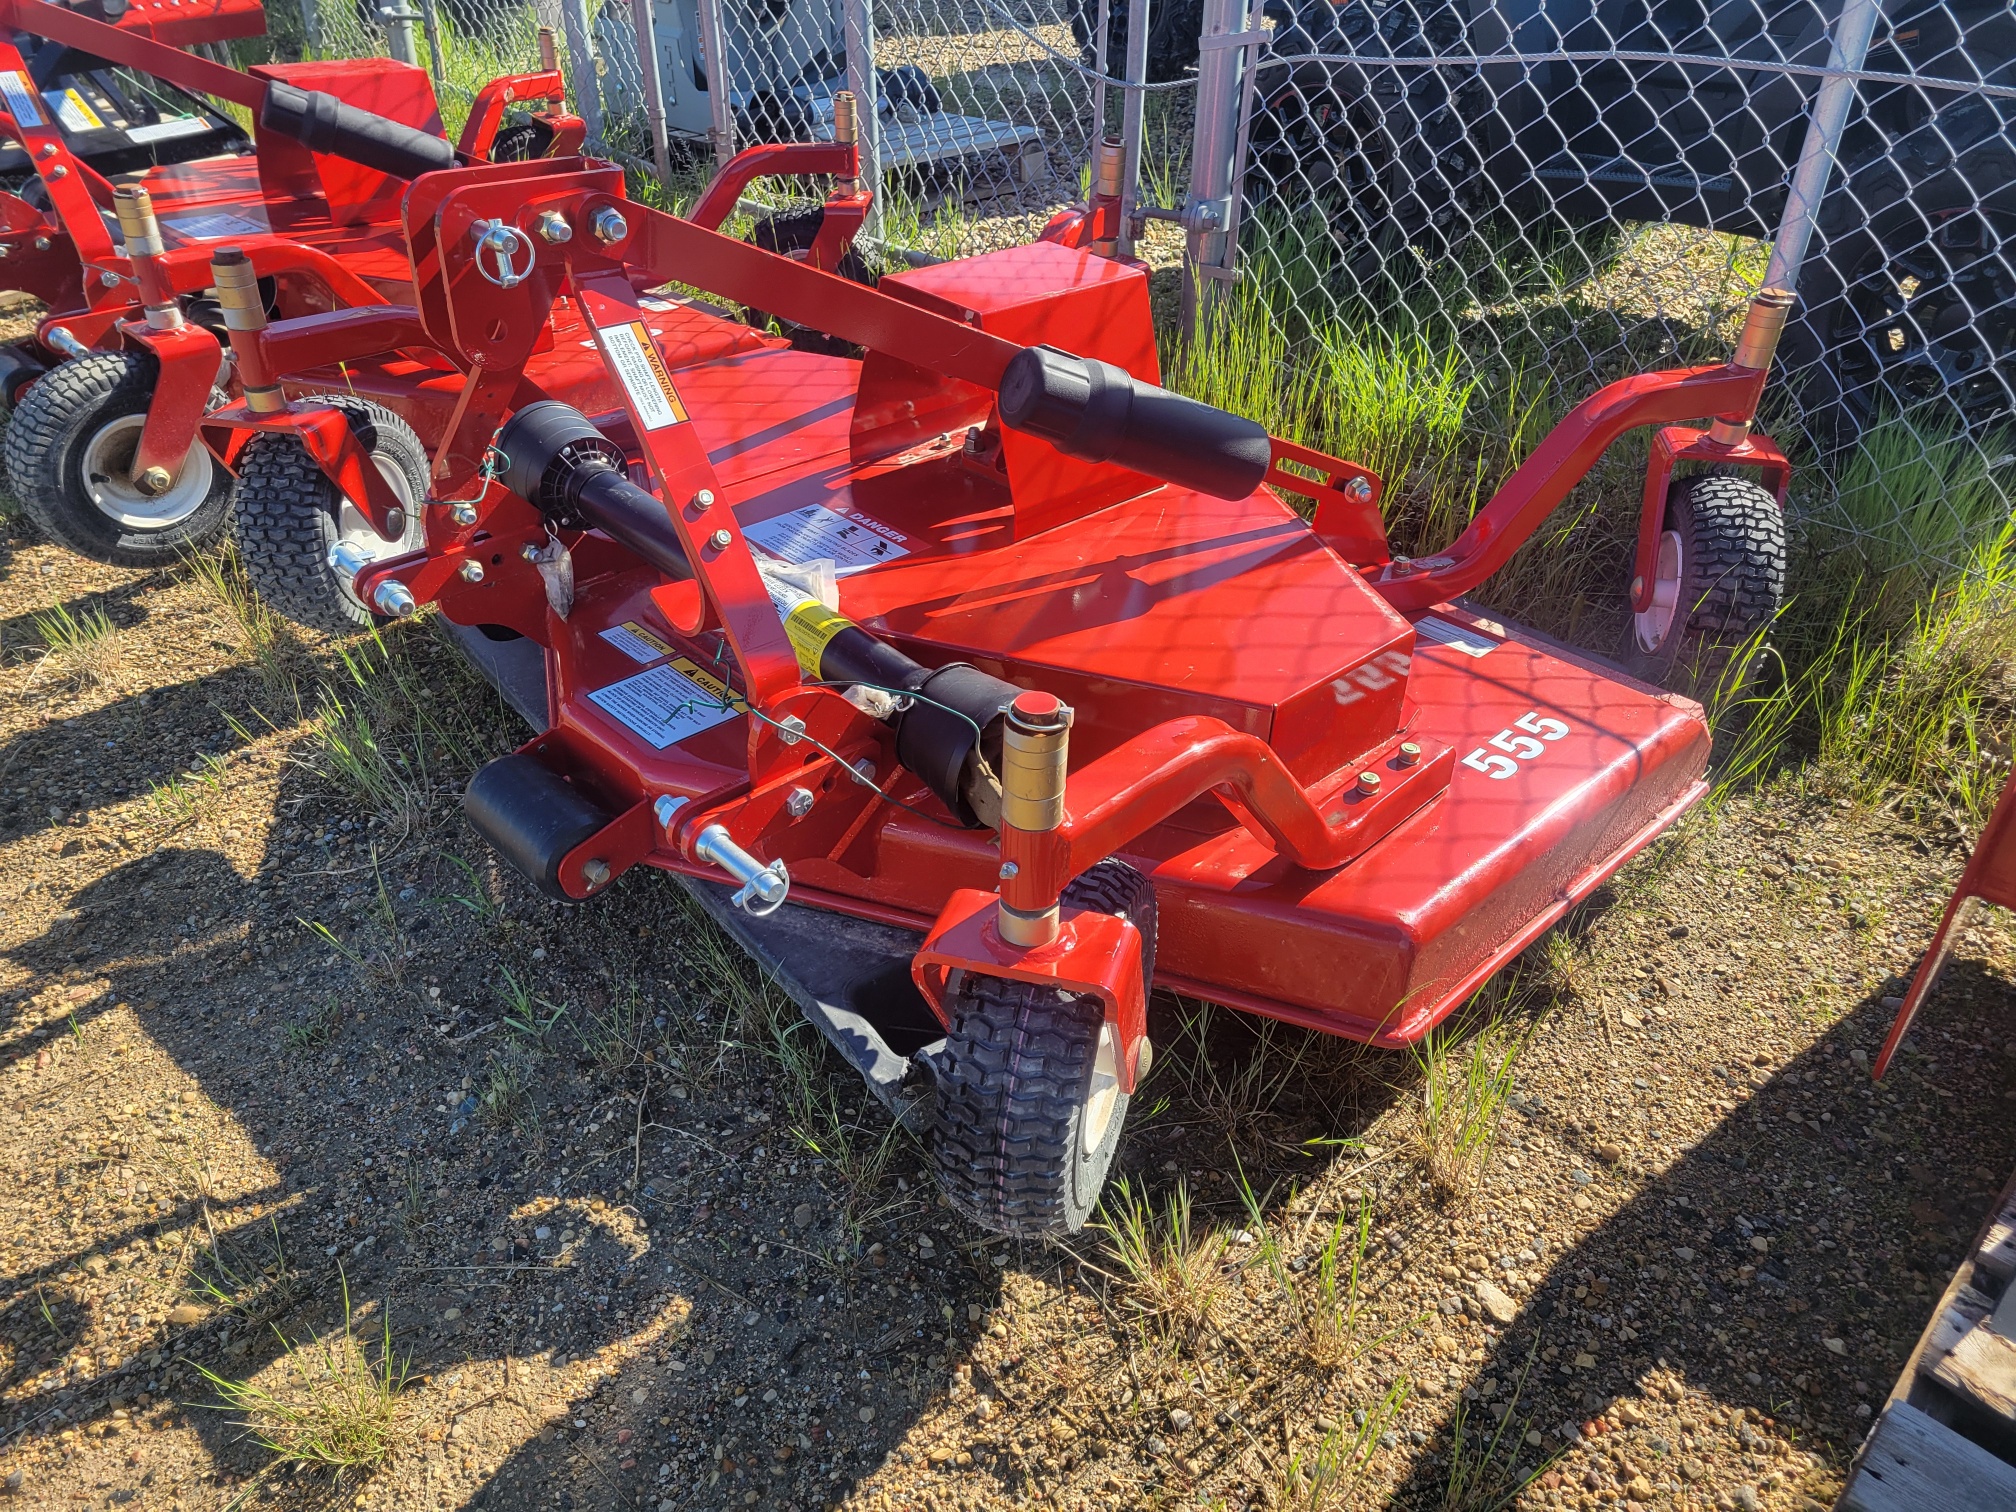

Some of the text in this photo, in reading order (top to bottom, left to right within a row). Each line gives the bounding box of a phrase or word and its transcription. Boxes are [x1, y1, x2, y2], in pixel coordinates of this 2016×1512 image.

[608, 336, 622, 358] BOTTOM
[625, 369, 640, 395] SEPARATE
[619, 333, 632, 354] BEFORE
[630, 356, 643, 377] RAISING
[645, 387, 662, 415] LOWERING
[624, 332, 662, 402] CHECK PTO SHAFT LENGTH
[630, 368, 641, 385] SHAFT
[638, 386, 648, 400] MUST
[647, 353, 676, 402] WARNING
[849, 512, 908, 543] DANGER
[839, 546, 859, 556] BLADES
[638, 632, 666, 651] CAUTION
[696, 676, 733, 706] CAUTION
[1460, 711, 1571, 780] 555
